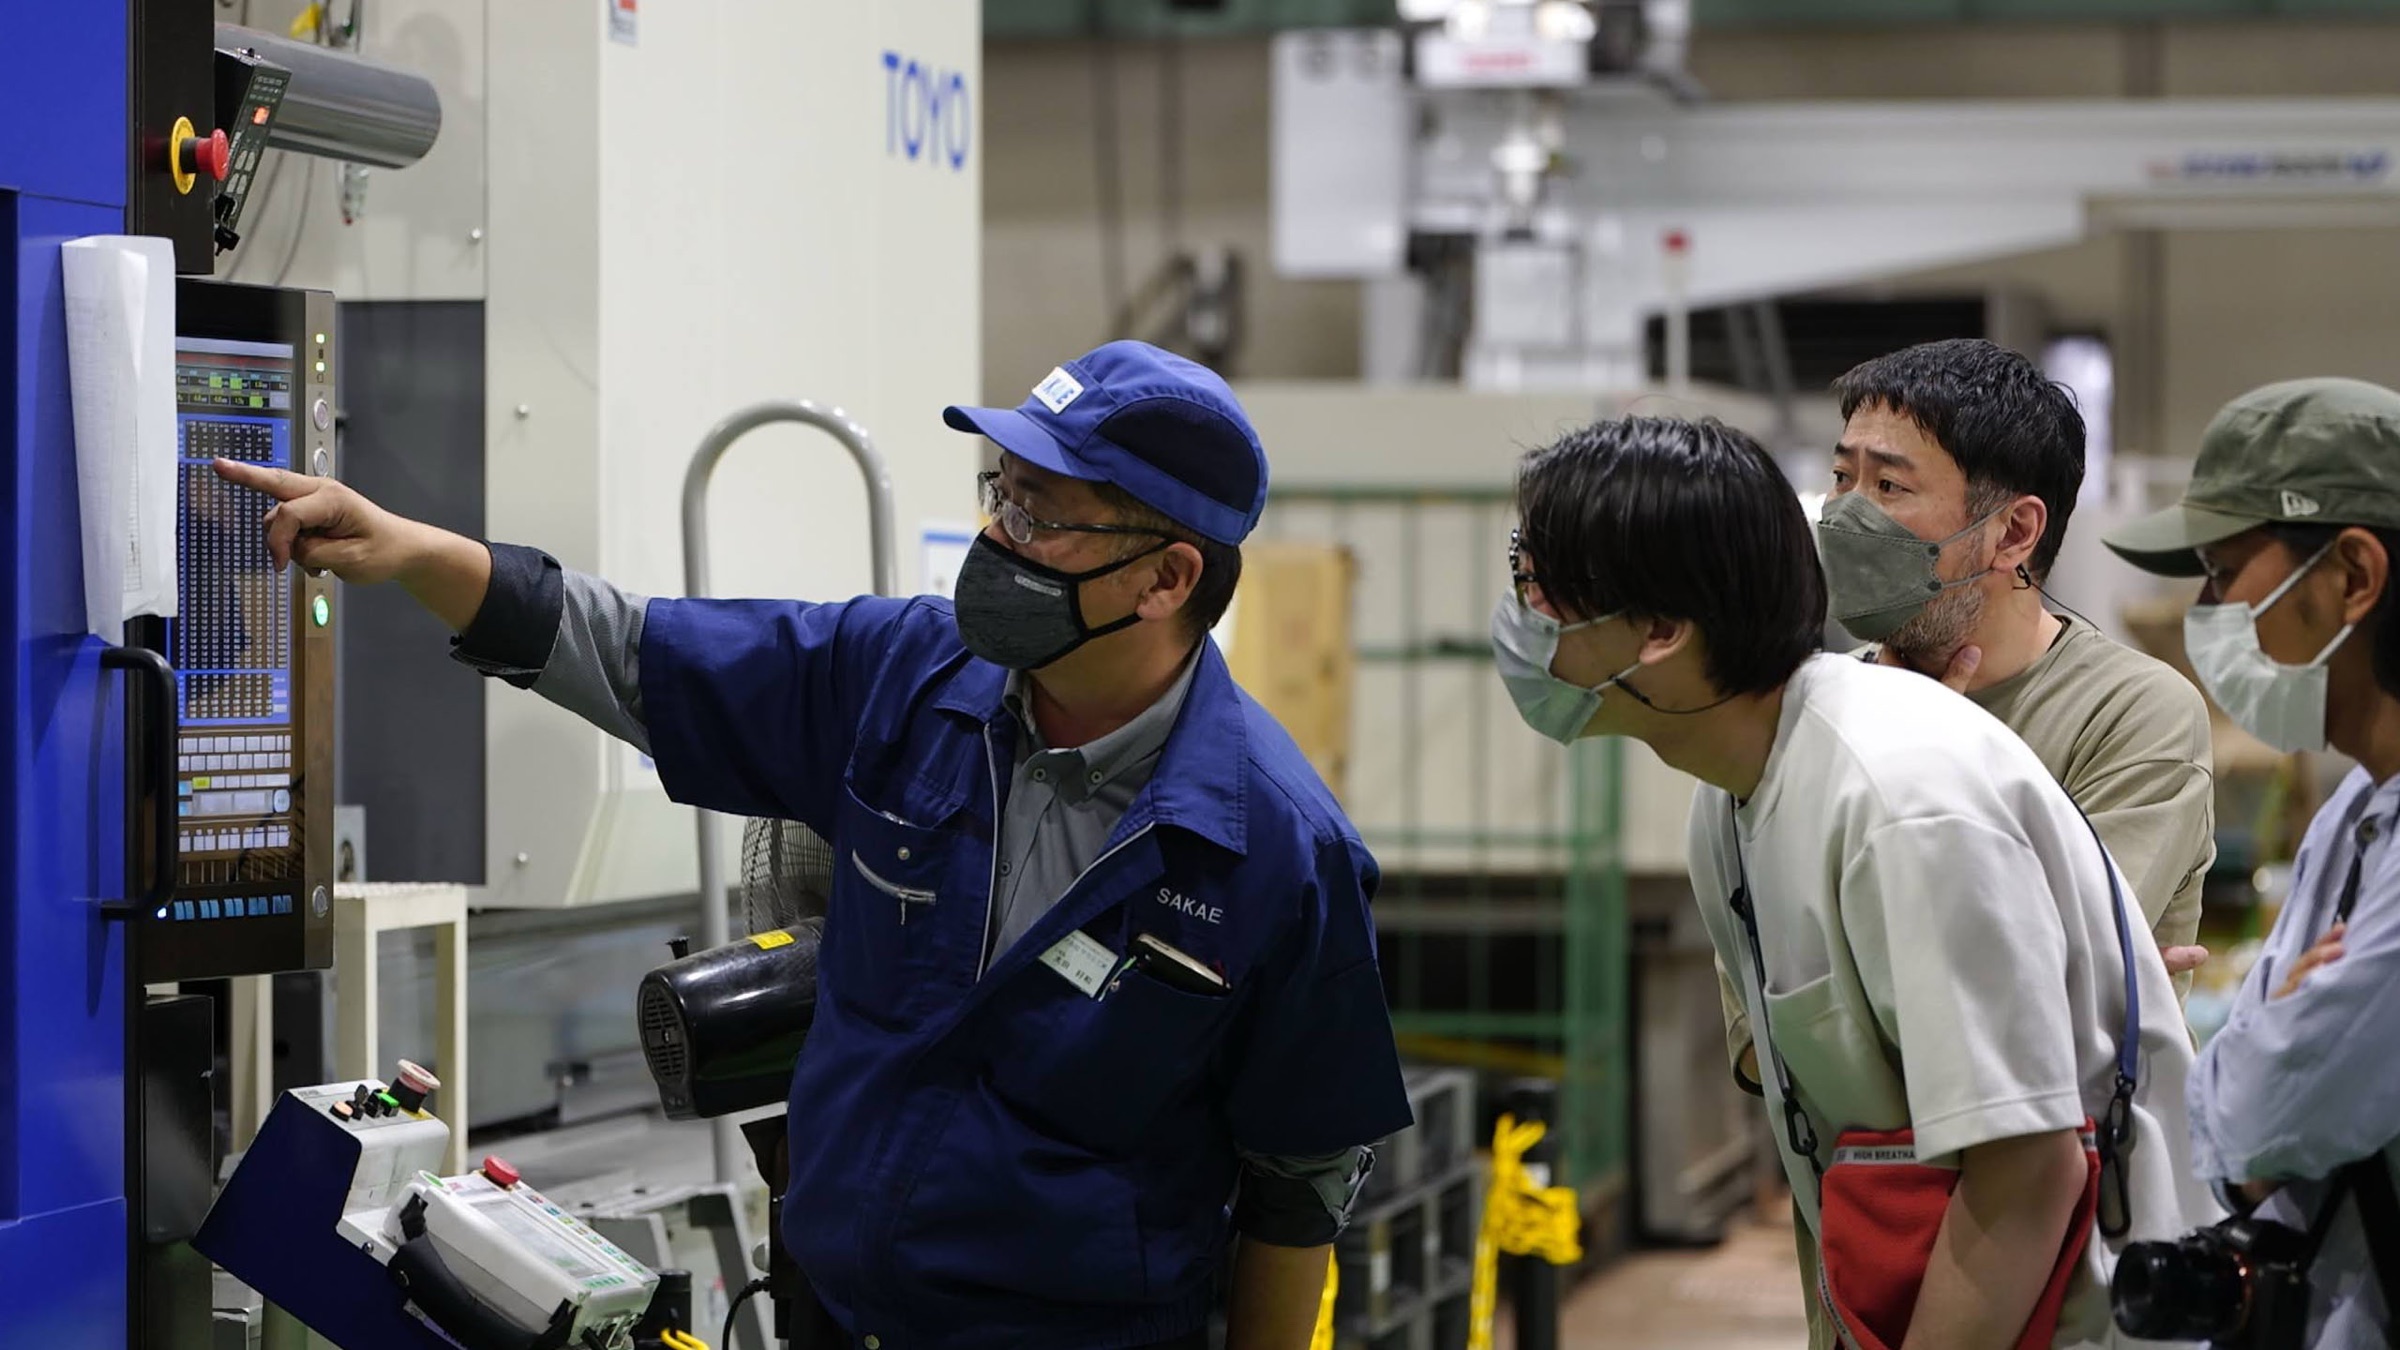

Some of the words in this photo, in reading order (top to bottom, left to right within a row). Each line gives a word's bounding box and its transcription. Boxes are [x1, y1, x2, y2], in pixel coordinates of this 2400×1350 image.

[880, 50, 972, 172] TOYO
[1156, 887, 1224, 925] SAKAE
[1853, 1150, 1873, 1160] HIGH
